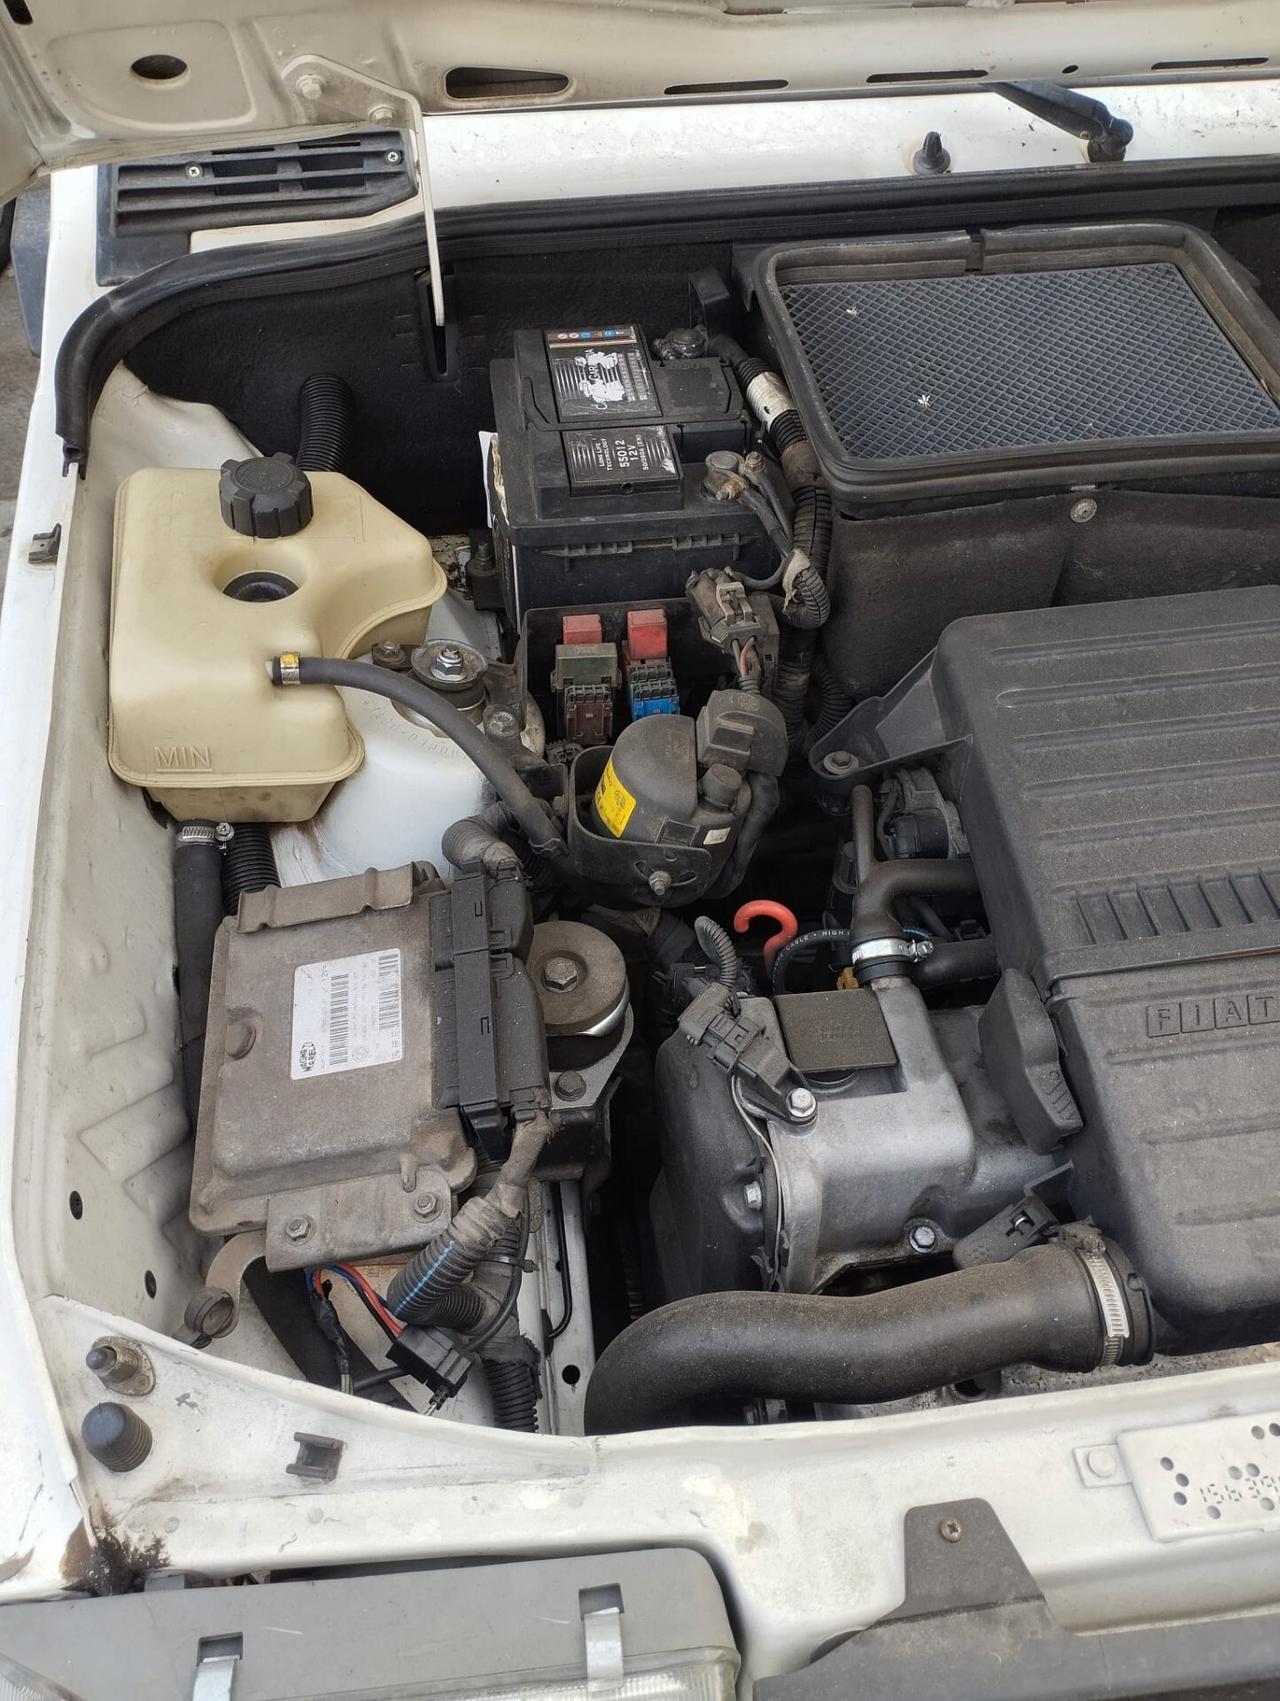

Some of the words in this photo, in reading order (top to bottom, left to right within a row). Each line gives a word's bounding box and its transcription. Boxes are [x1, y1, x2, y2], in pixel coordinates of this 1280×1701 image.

[597, 452, 605, 467] LONG
[601, 438, 613, 471] TECHNOLOGY
[614, 439, 630, 468] 55012
[627, 444, 638, 461] 12V
[153, 746, 212, 768] MIN
[785, 935, 809, 951] CABLE
[1157, 995, 1275, 1031] FIAT
